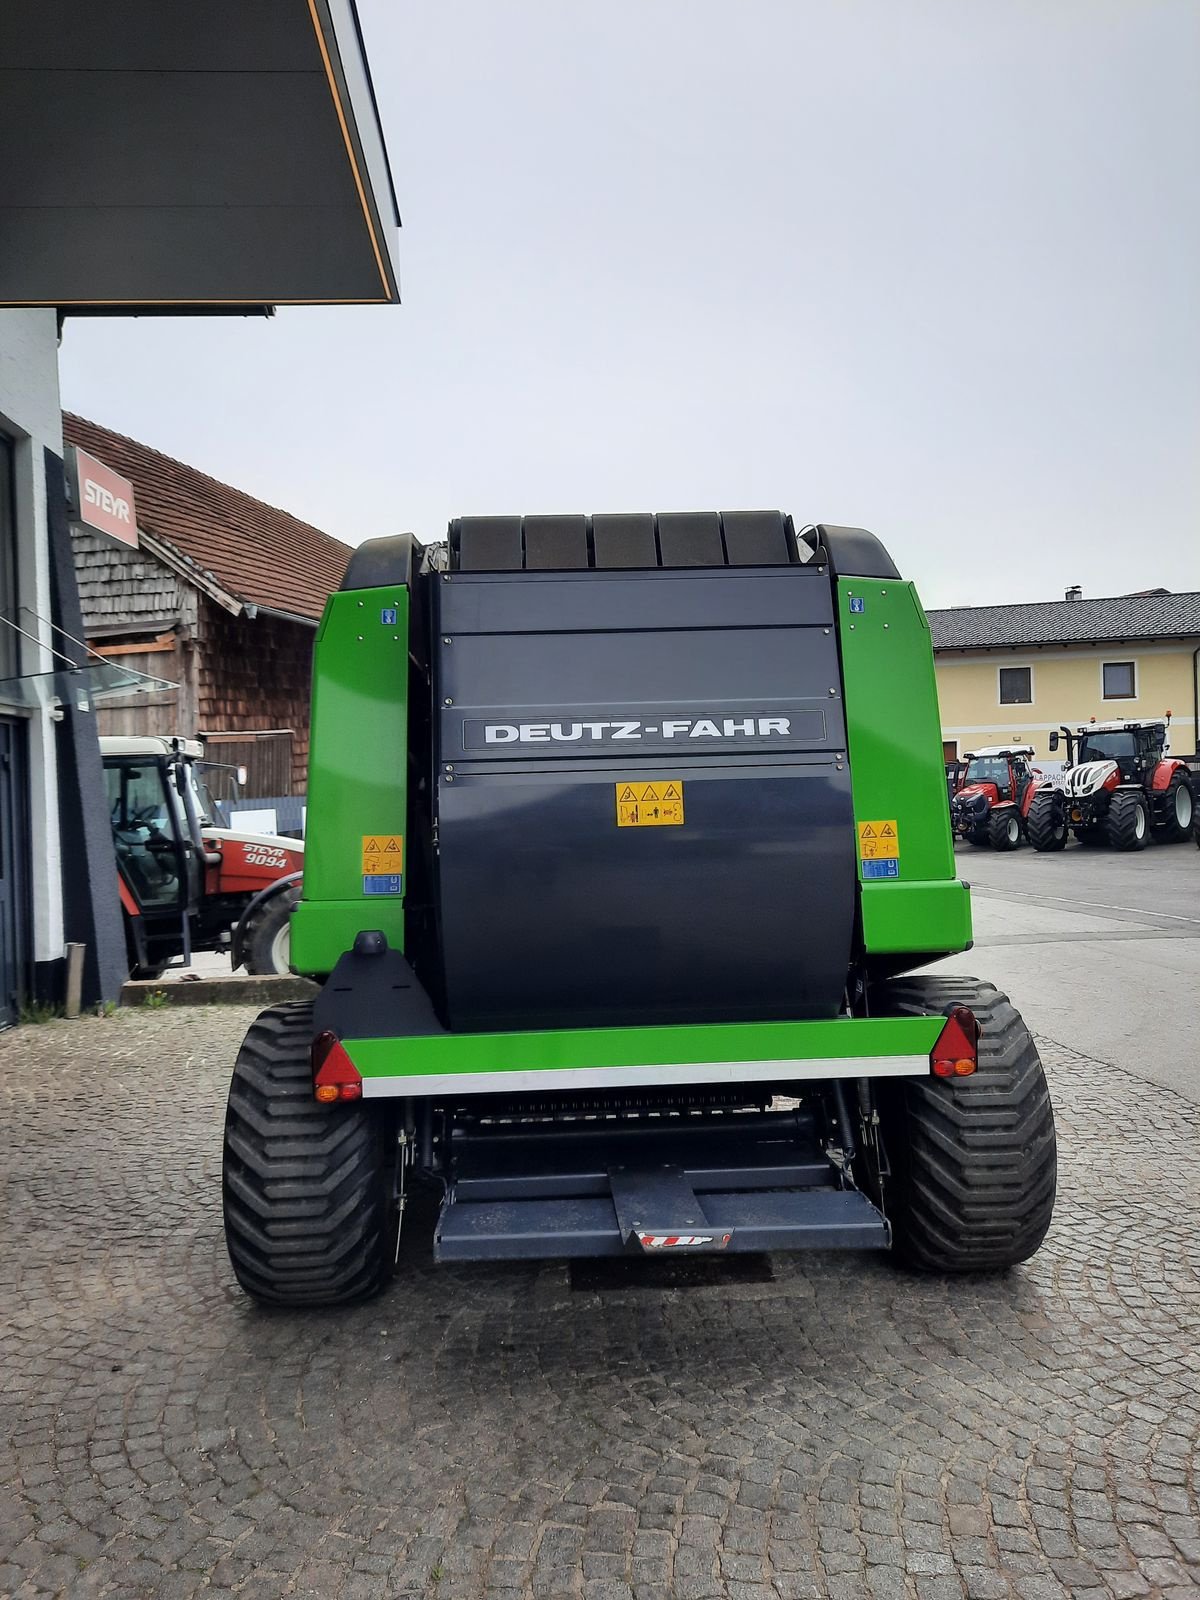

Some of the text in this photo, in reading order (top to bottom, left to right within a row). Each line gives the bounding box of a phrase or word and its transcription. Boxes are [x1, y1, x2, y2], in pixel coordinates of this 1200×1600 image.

[84, 479, 130, 524] STEYR
[484, 717, 791, 743] DEUTZ-FAHR
[242, 844, 285, 857] STEYR
[245, 853, 287, 869] 9094
